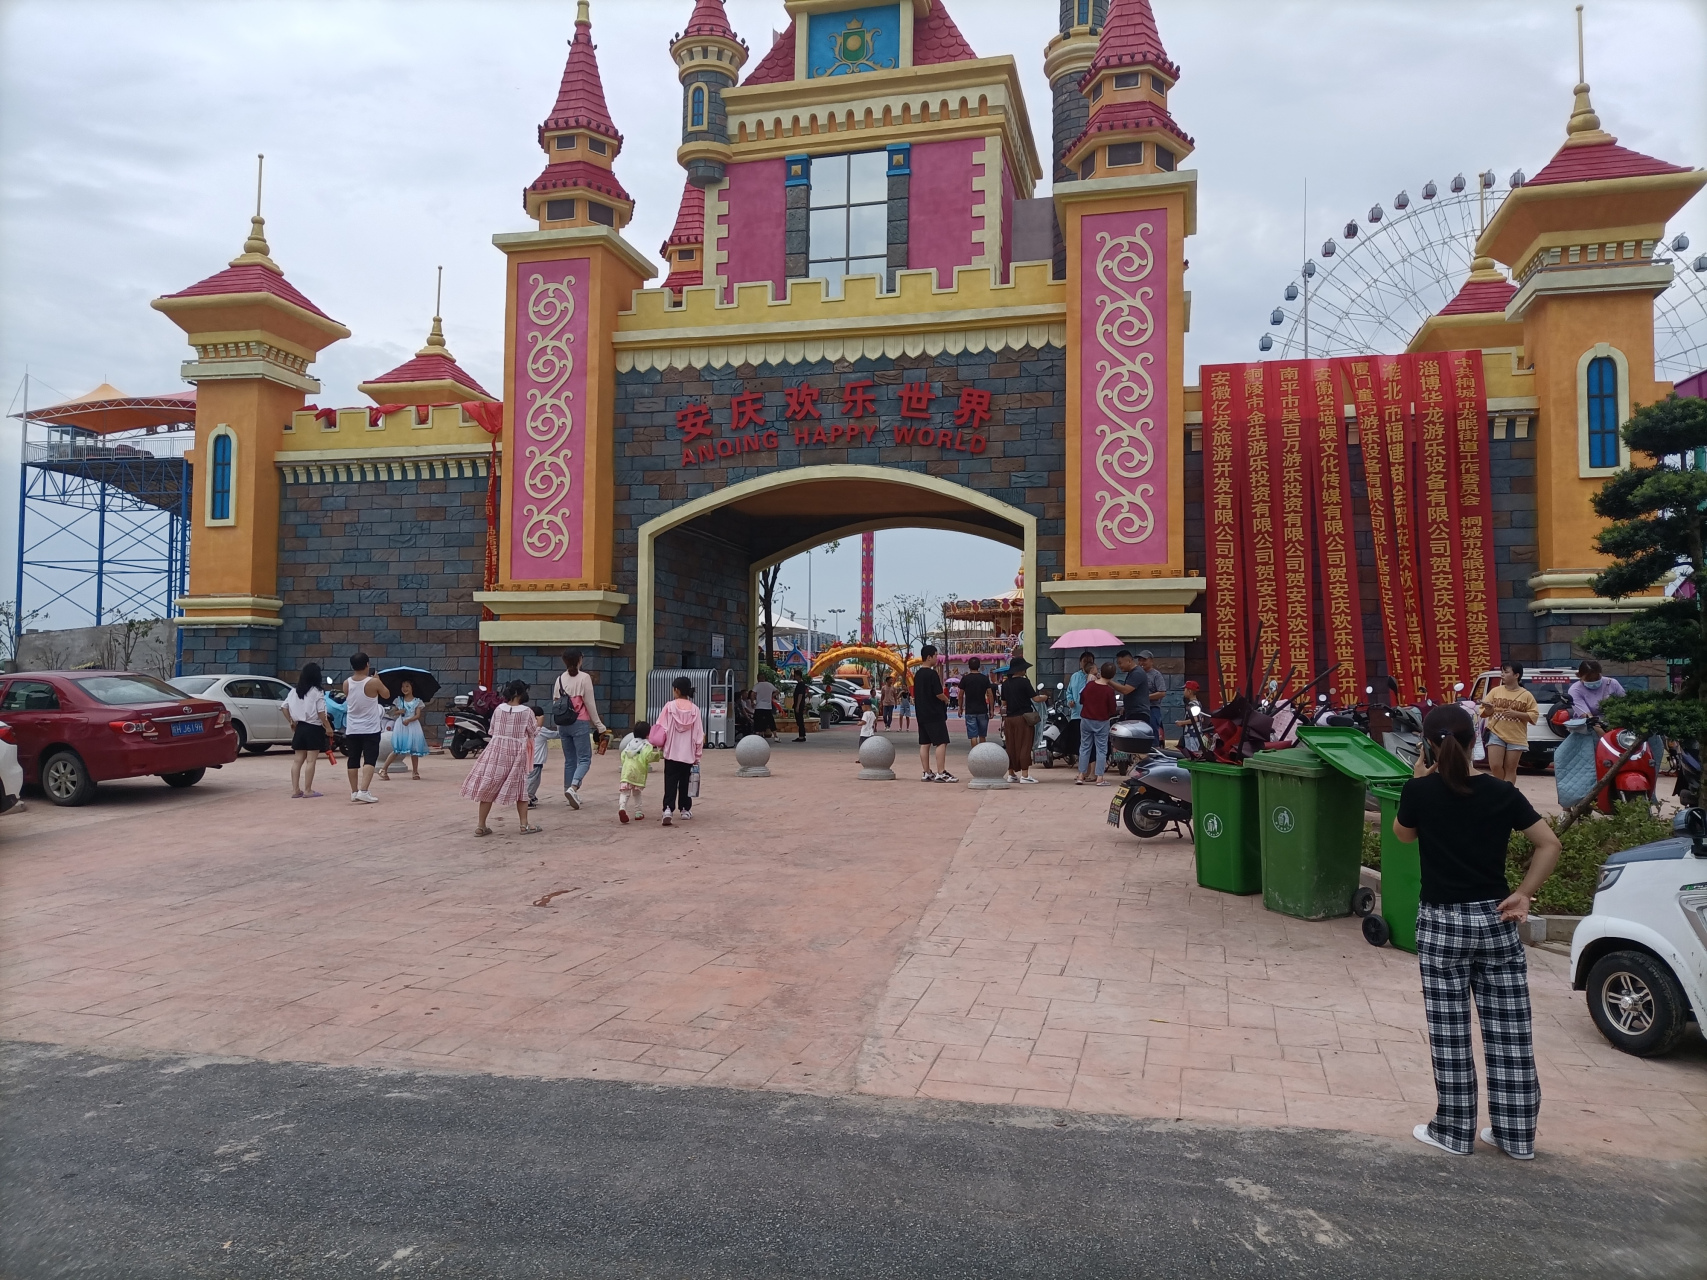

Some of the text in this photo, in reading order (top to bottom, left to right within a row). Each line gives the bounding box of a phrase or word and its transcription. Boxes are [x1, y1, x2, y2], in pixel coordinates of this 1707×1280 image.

[675, 380, 993, 442] 安庆欢乐世界
[681, 425, 987, 467] ANQING HAPPY WORLD
